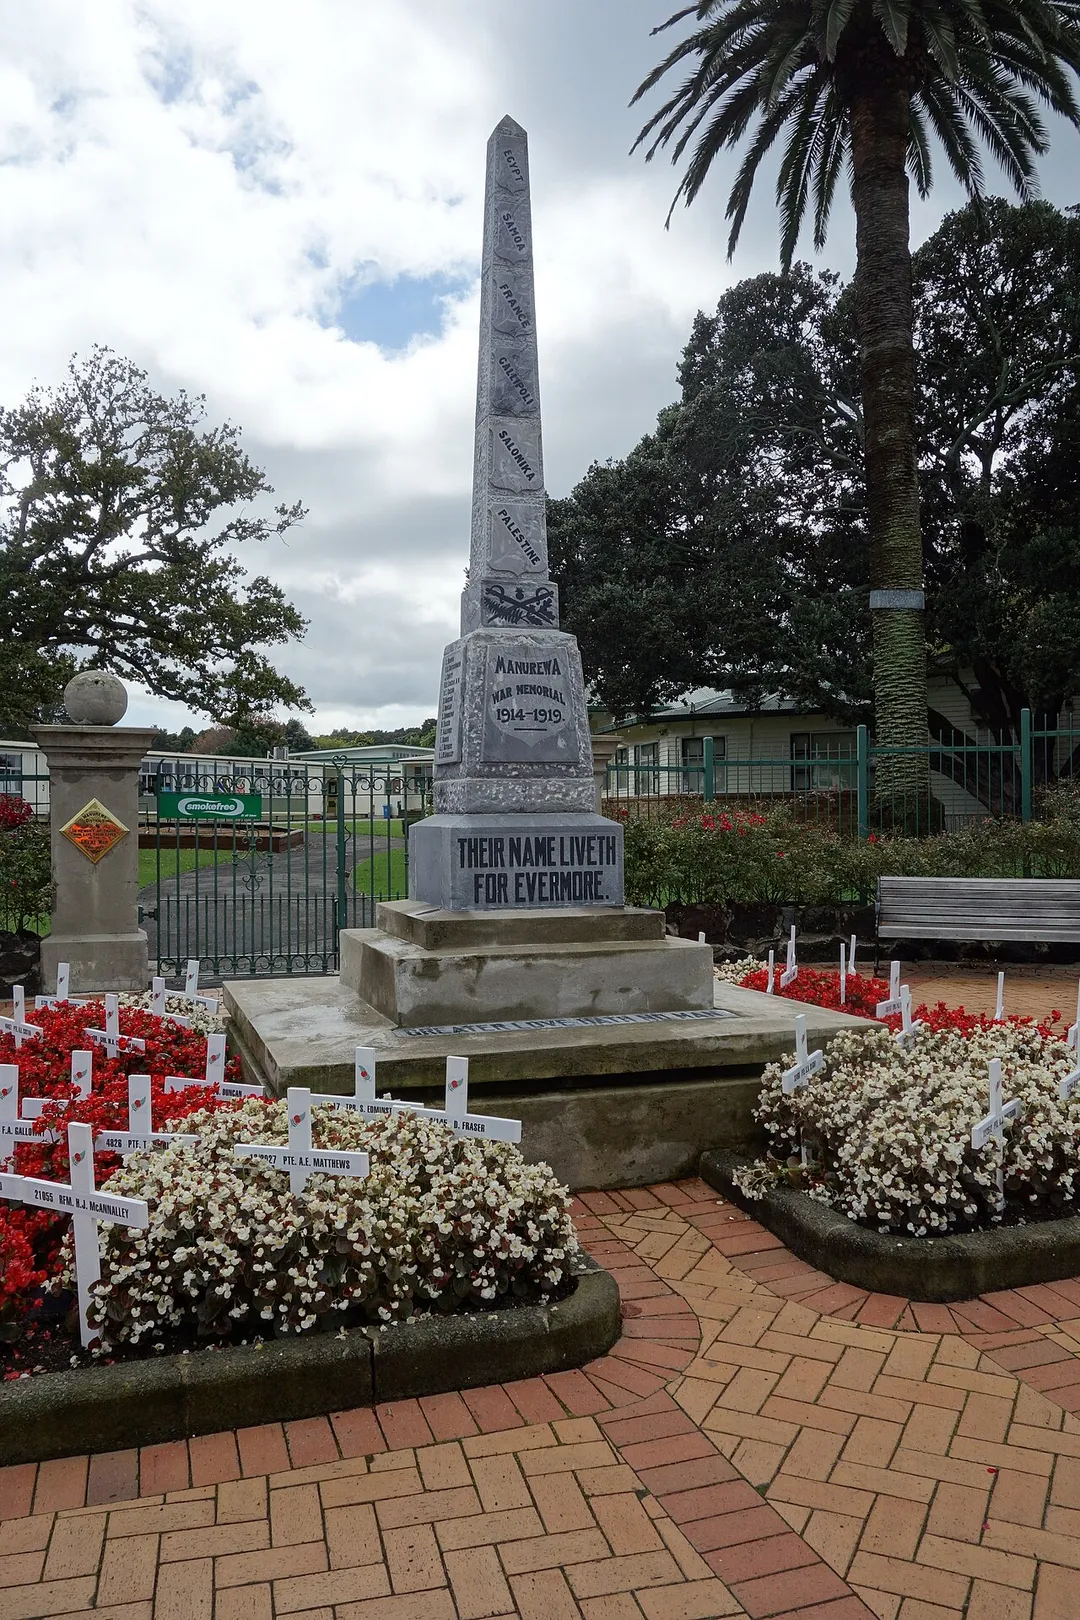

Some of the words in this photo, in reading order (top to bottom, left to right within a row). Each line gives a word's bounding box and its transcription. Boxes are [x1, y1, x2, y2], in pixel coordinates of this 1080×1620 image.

[503, 149, 524, 183] EGYPT
[502, 213, 526, 252] SAMOA
[499, 283, 531, 330] FRANCE
[498, 357, 535, 406] GALLIPOLI
[498, 430, 536, 482] SALONIKA
[497, 508, 541, 567] PALESTINE
[494, 655, 561, 676] MANUREWA
[491, 686, 512, 705] WAR
[516, 684, 566, 706] MEMORIAL
[186, 802, 235, 811] smokefree
[457, 837, 505, 868] THEIR
[508, 836, 556, 867] NAME
[560, 835, 616, 866] LIVETH
[473, 872, 508, 904] FOR
[514, 870, 610, 903] EVERMORE.
[406, 1022, 507, 1037] GREATER
[510, 1019, 568, 1029] LOVE
[672, 1010, 724, 1020] MAN
[222, 1088, 242, 1097] DUNCAN
[367, 1105, 392, 1114] EDMINST
[453, 1120, 460, 1129] D.
[462, 1121, 486, 1133] FRASER
[127, 1139, 141, 1149] PTE.
[283, 1155, 297, 1166] PTE.
[298, 1156, 311, 1167] A.E.
[313, 1157, 351, 1170] MATTHEWS
[34, 1189, 54, 1203] 21055
[58, 1194, 74, 1207] RFM.
[75, 1197, 88, 1210] H.J.
[89, 1201, 129, 1219] McANNALLEY
